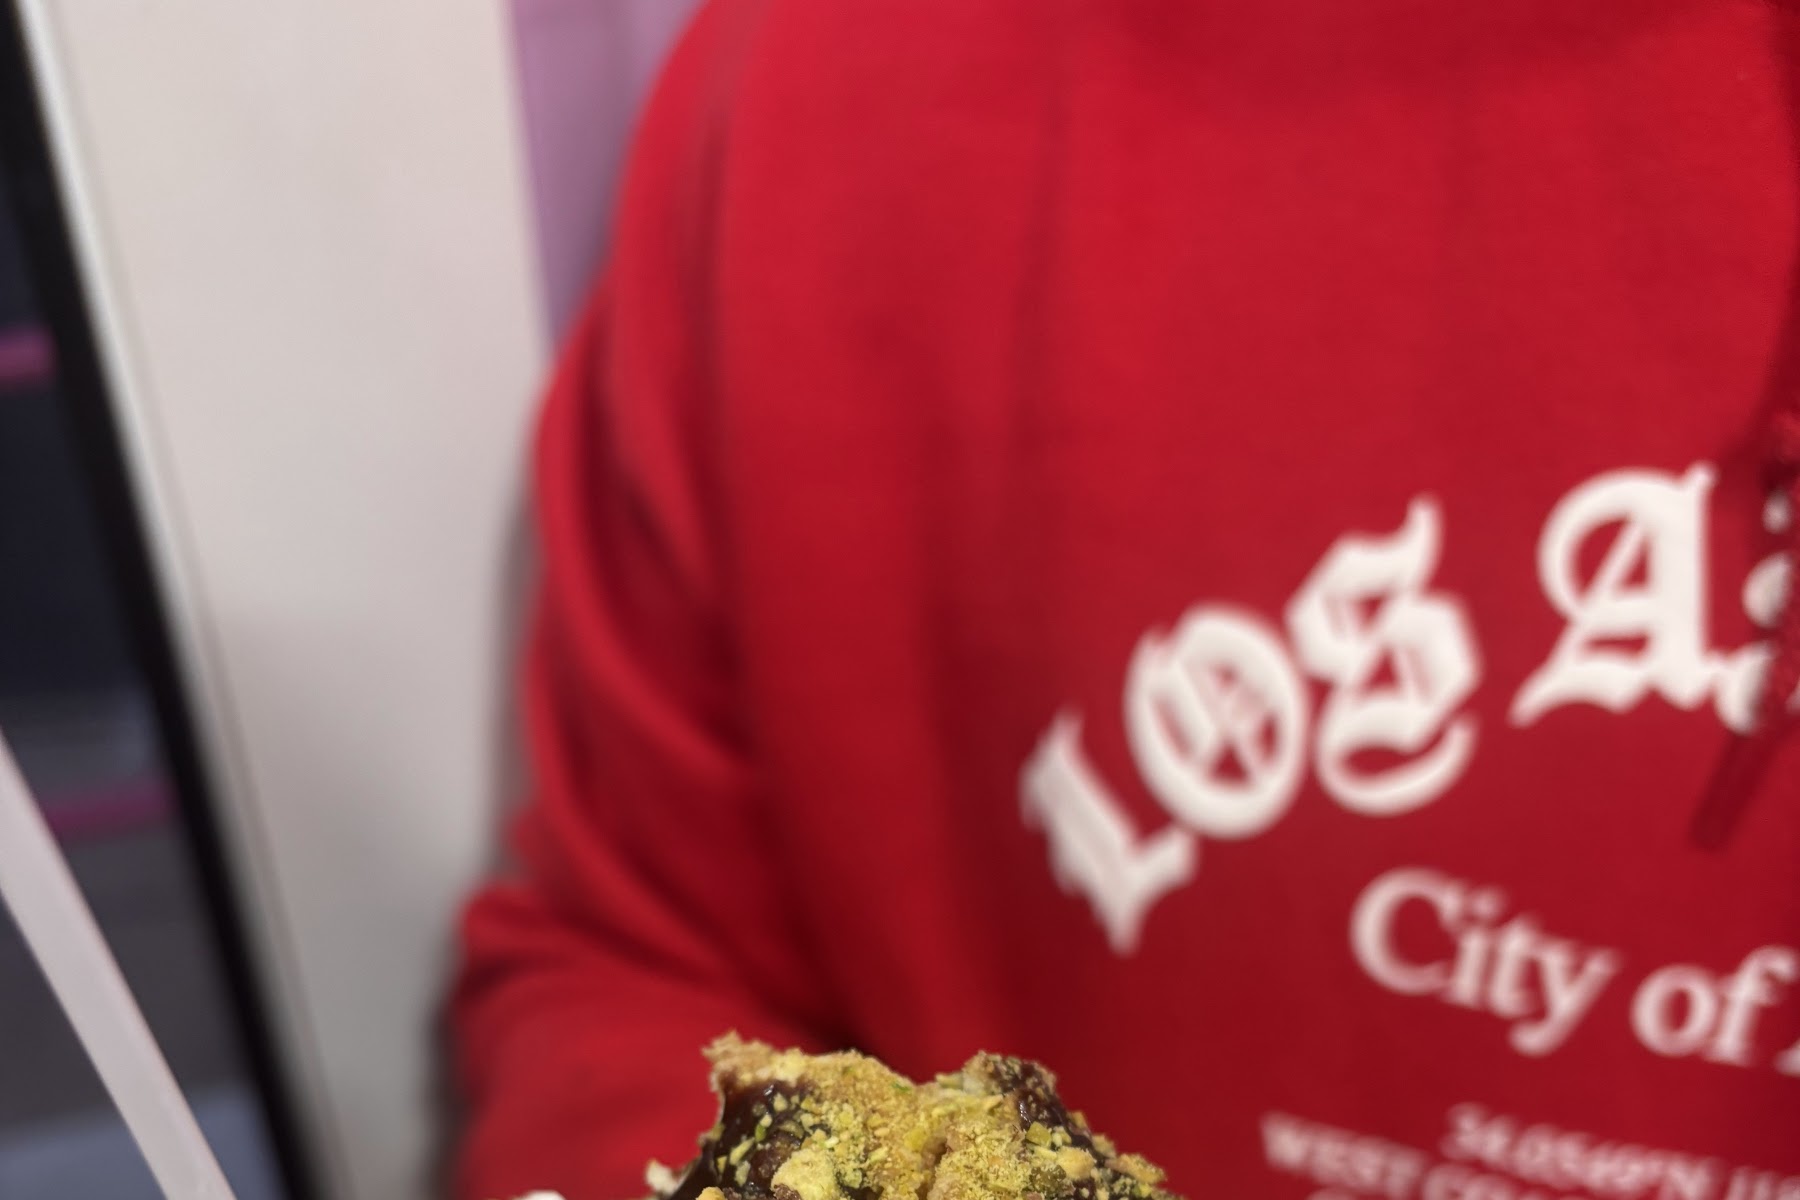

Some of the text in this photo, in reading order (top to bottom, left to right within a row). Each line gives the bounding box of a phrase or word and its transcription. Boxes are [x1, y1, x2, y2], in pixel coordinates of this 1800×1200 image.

[1020, 496, 1480, 956] LOS
[1349, 867, 1797, 1068] City of
